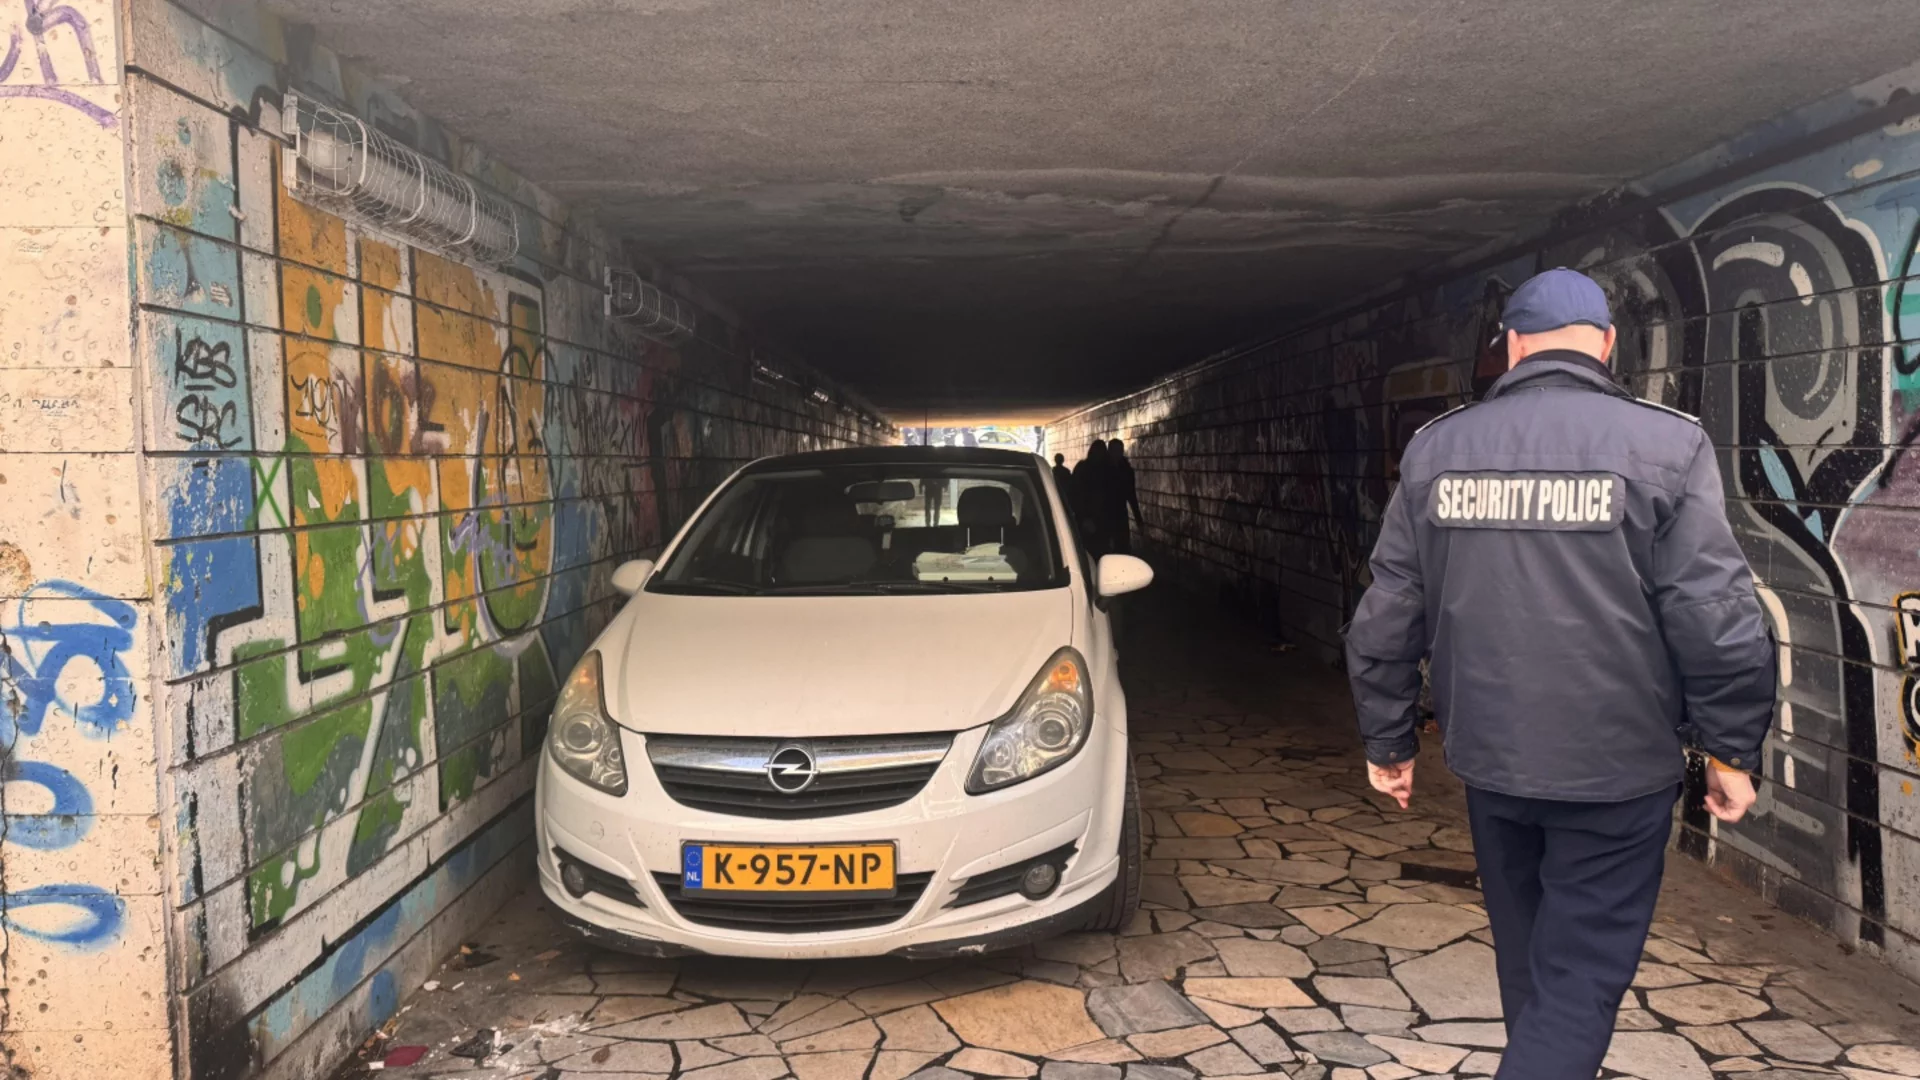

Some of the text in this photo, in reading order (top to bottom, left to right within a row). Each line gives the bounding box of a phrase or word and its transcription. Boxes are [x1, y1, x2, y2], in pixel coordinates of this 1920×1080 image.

[1438, 478, 1613, 522] SECURITY POLICE
[686, 871, 700, 882] NL
[714, 853, 881, 885] K-957-NP
